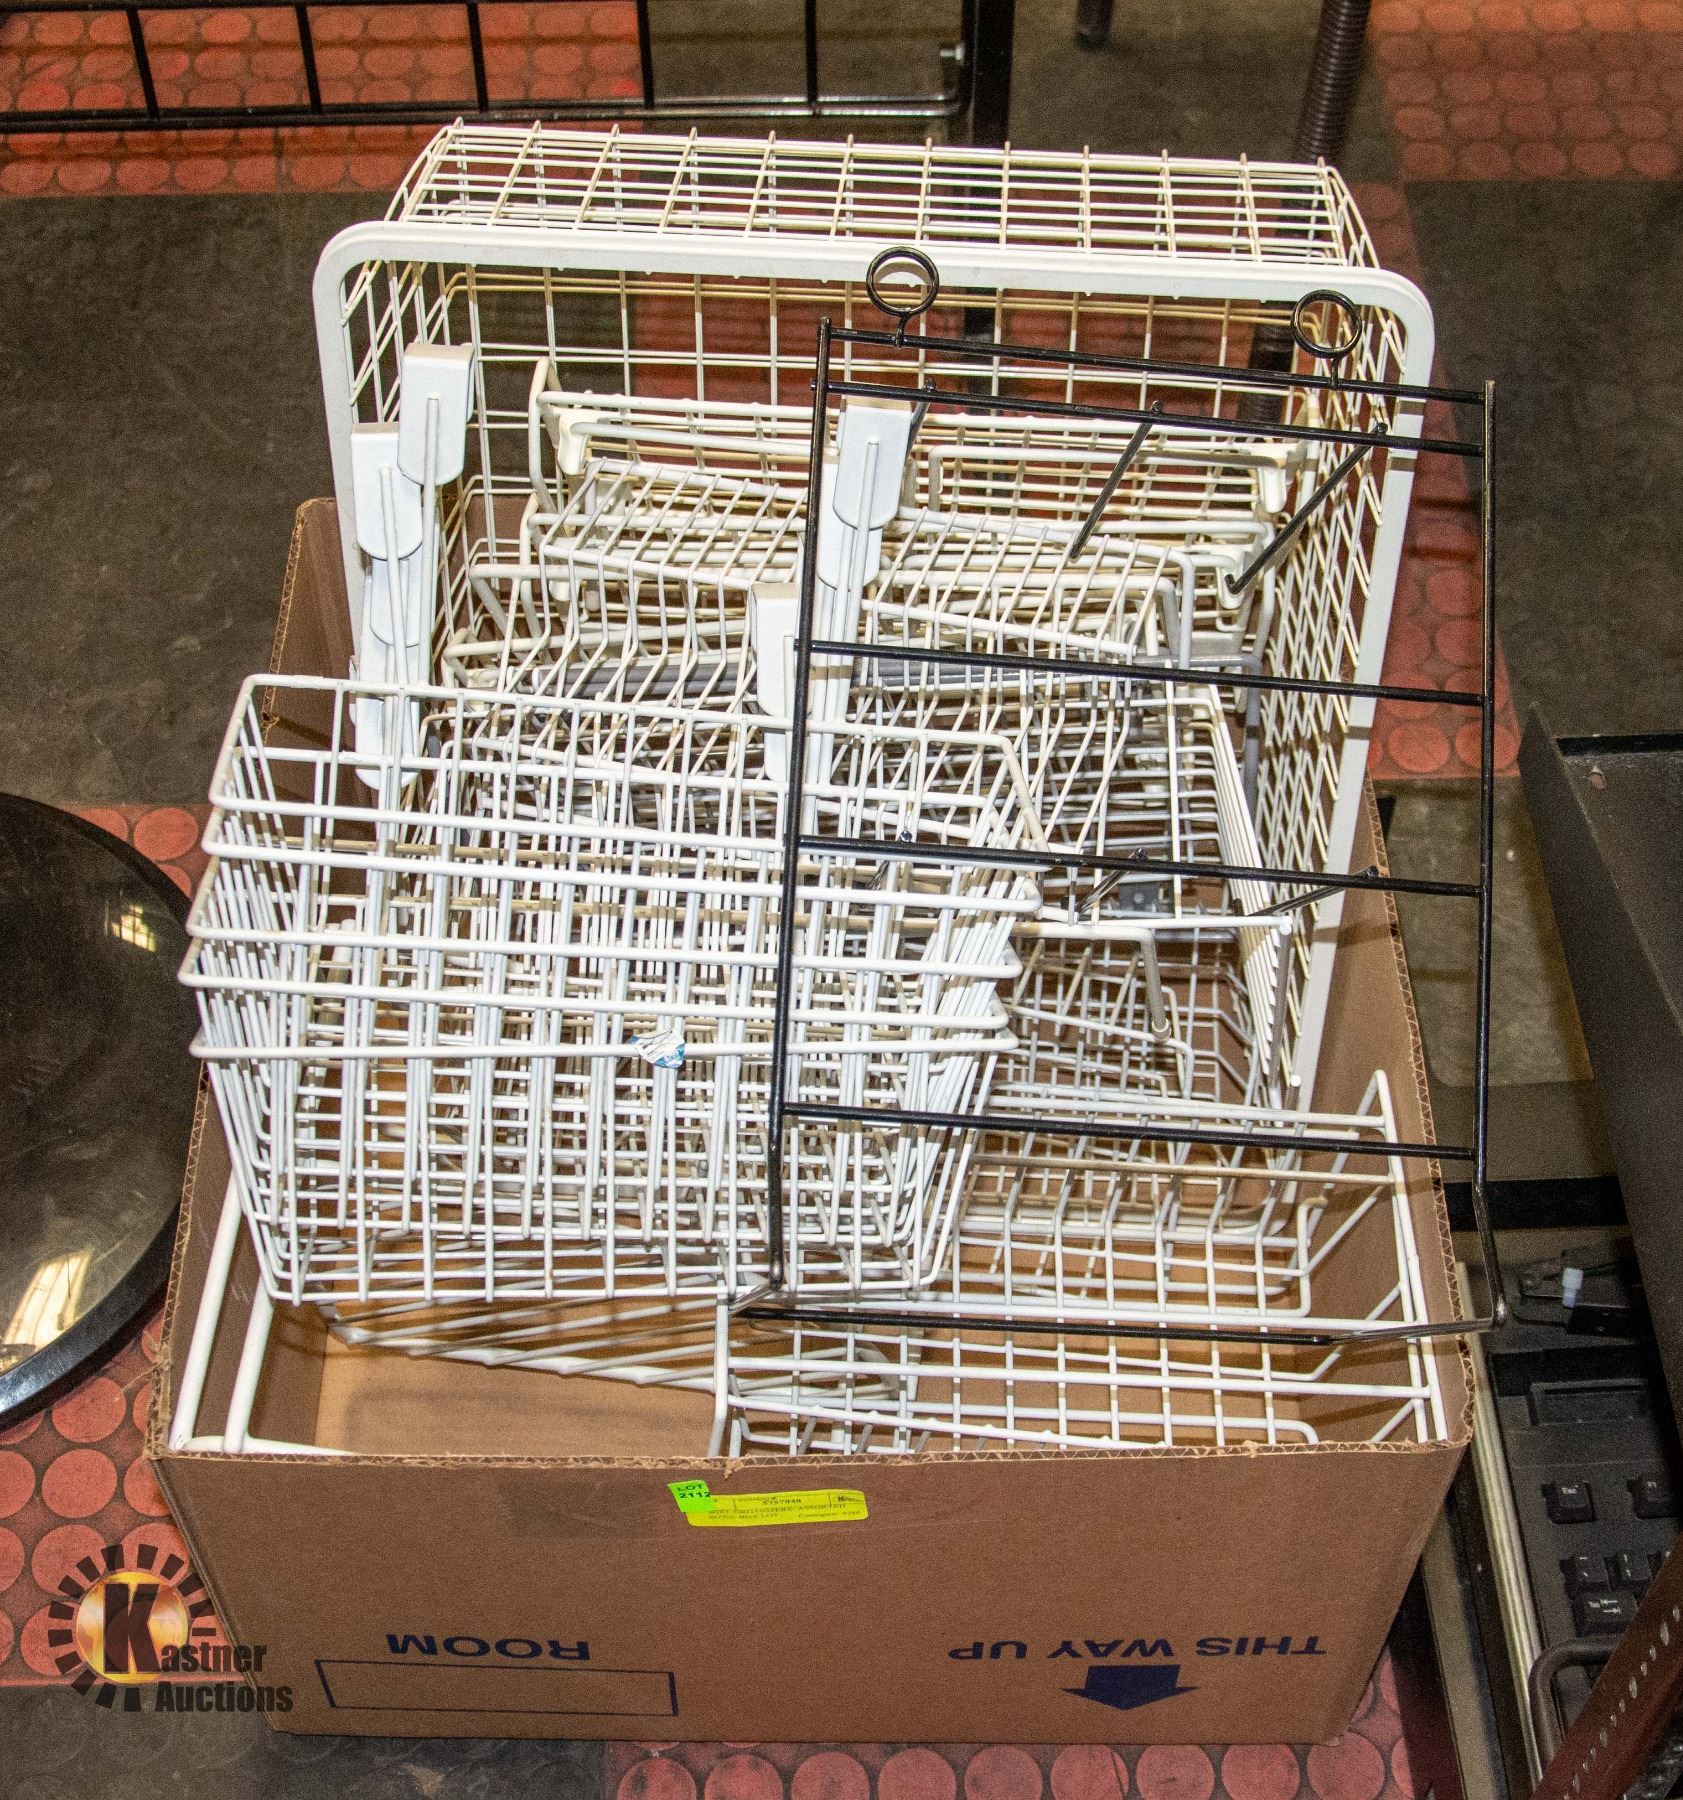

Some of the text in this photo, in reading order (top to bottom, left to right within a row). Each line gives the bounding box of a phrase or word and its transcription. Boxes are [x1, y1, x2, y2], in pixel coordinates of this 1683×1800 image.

[386, 1634, 590, 1661] ROOM
[947, 1636, 1327, 1660] THIS WAY UP
